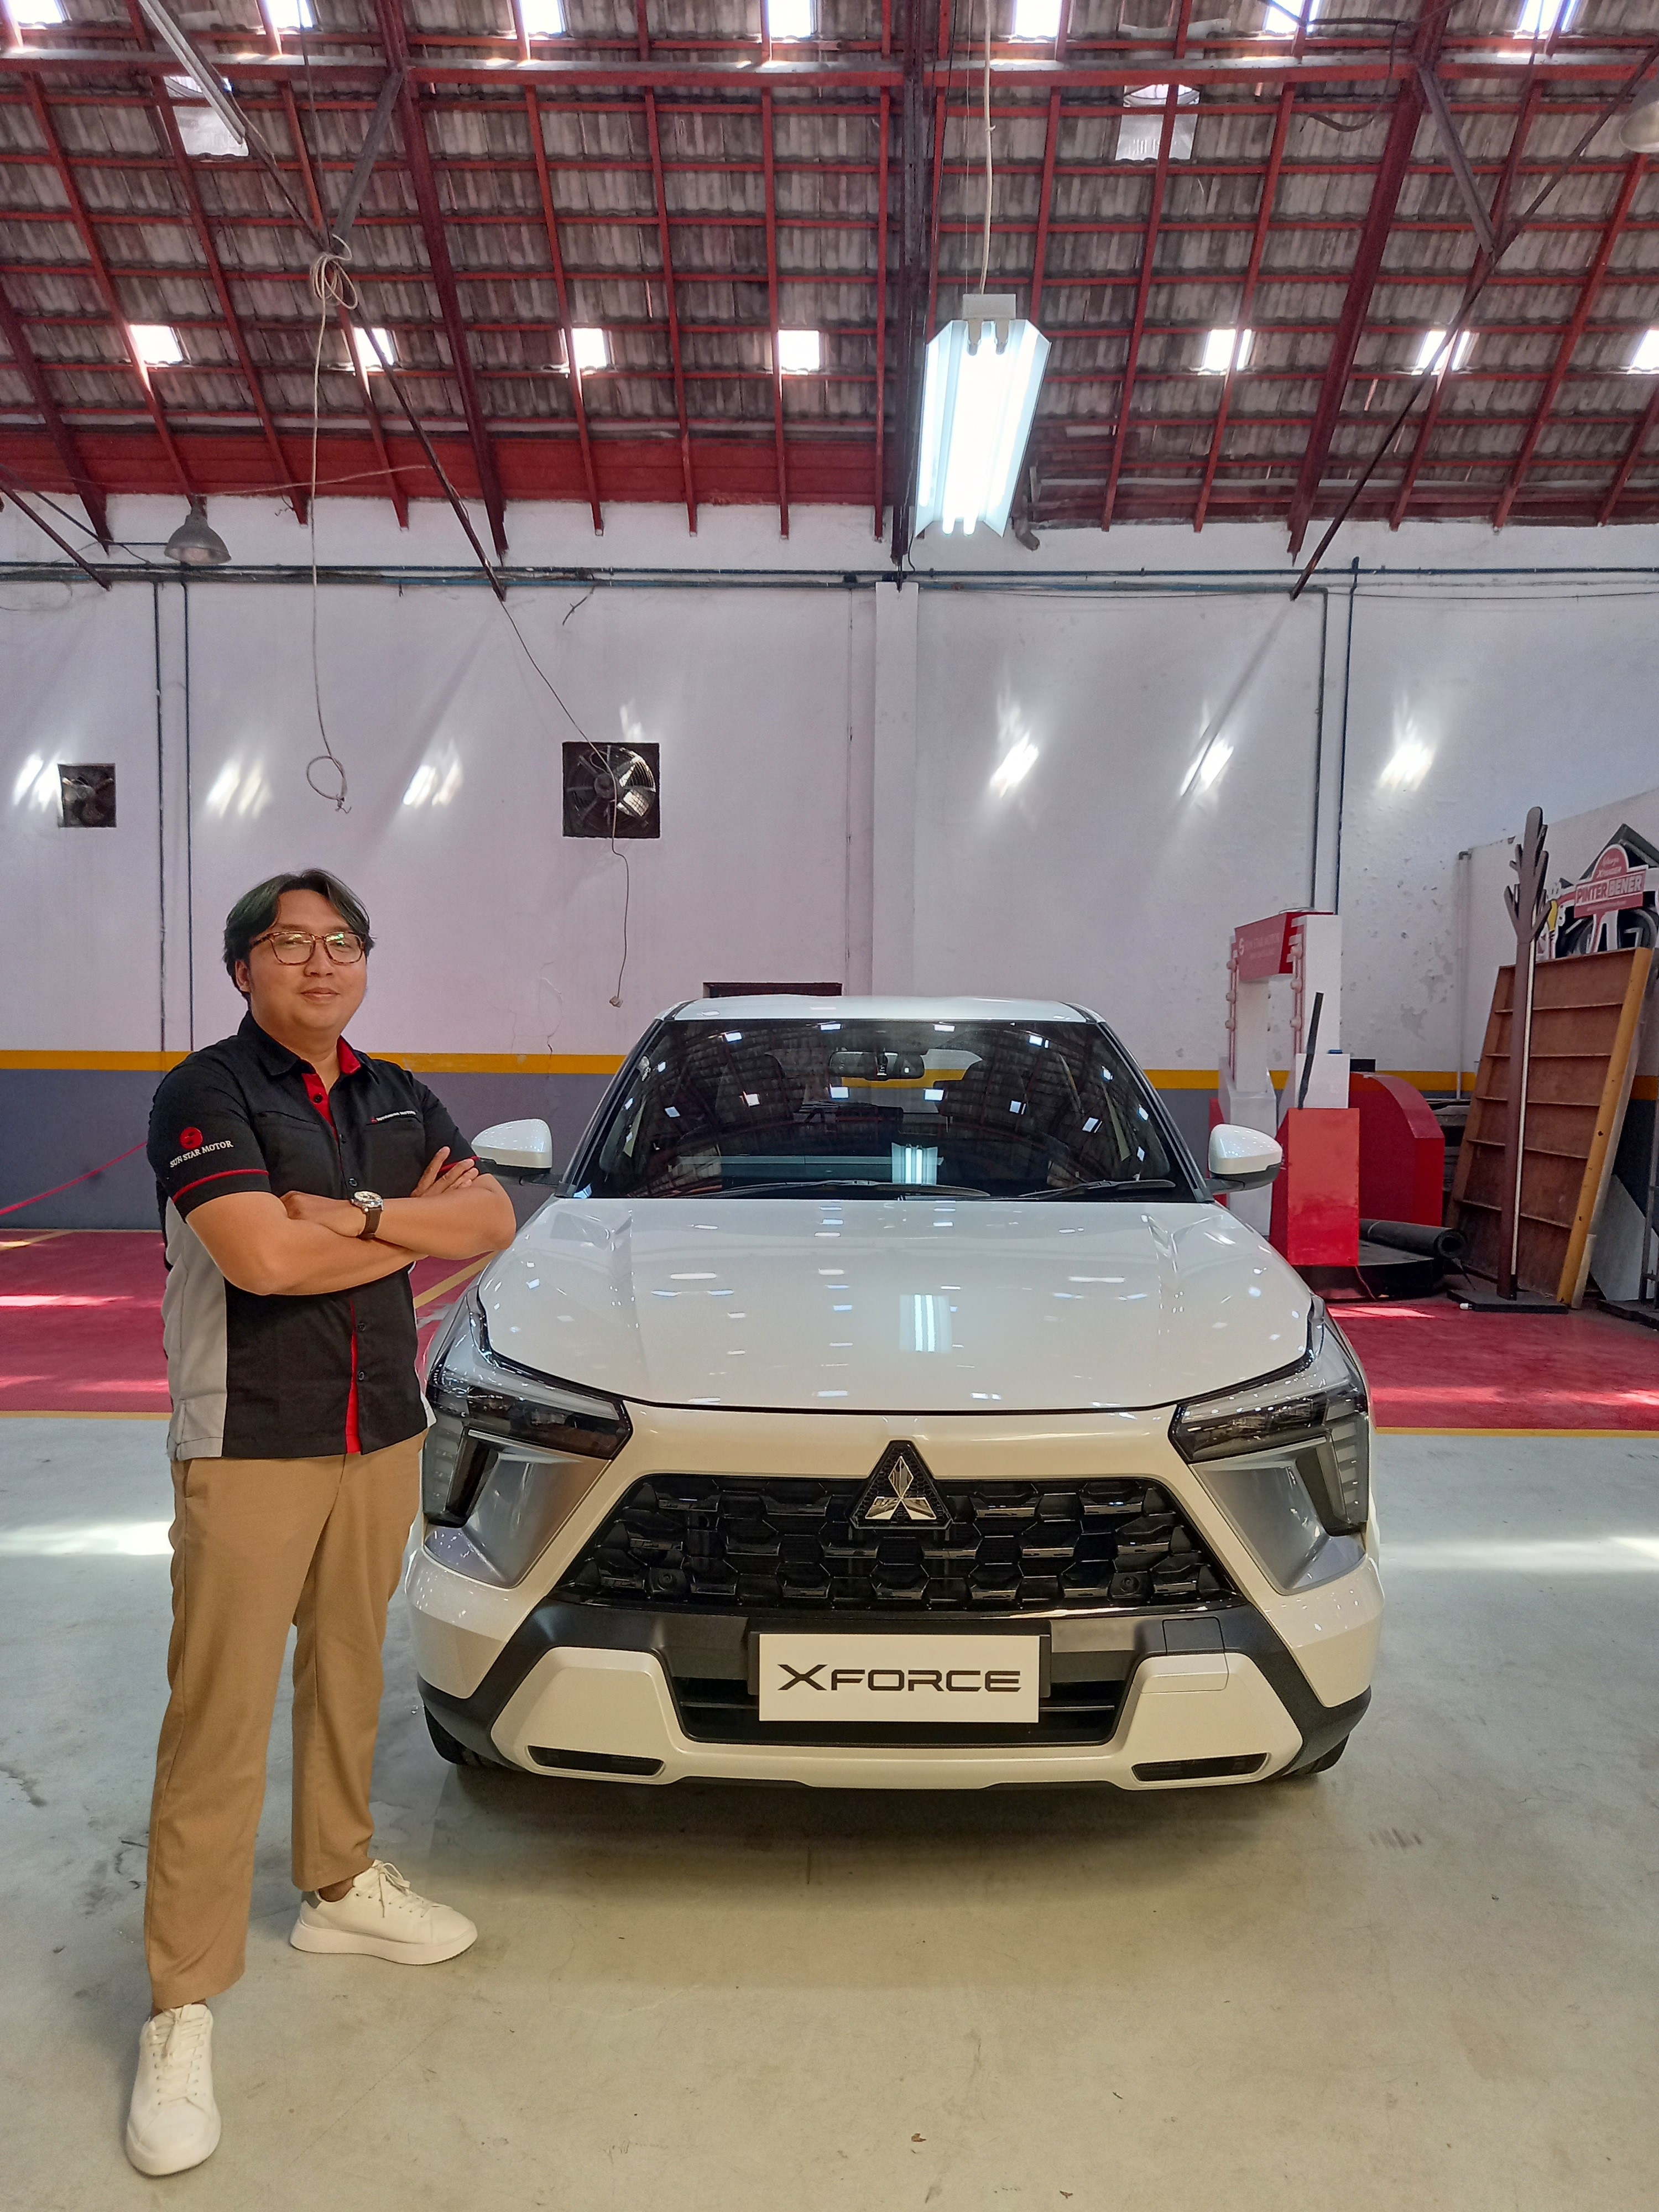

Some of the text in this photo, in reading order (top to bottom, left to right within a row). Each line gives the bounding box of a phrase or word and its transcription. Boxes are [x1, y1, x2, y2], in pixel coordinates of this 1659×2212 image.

[1576, 874, 1642, 904] PINTER BENER
[170, 1140, 234, 1168] SUN STAR MOTOR
[777, 1664, 1022, 1692] XFORCE
